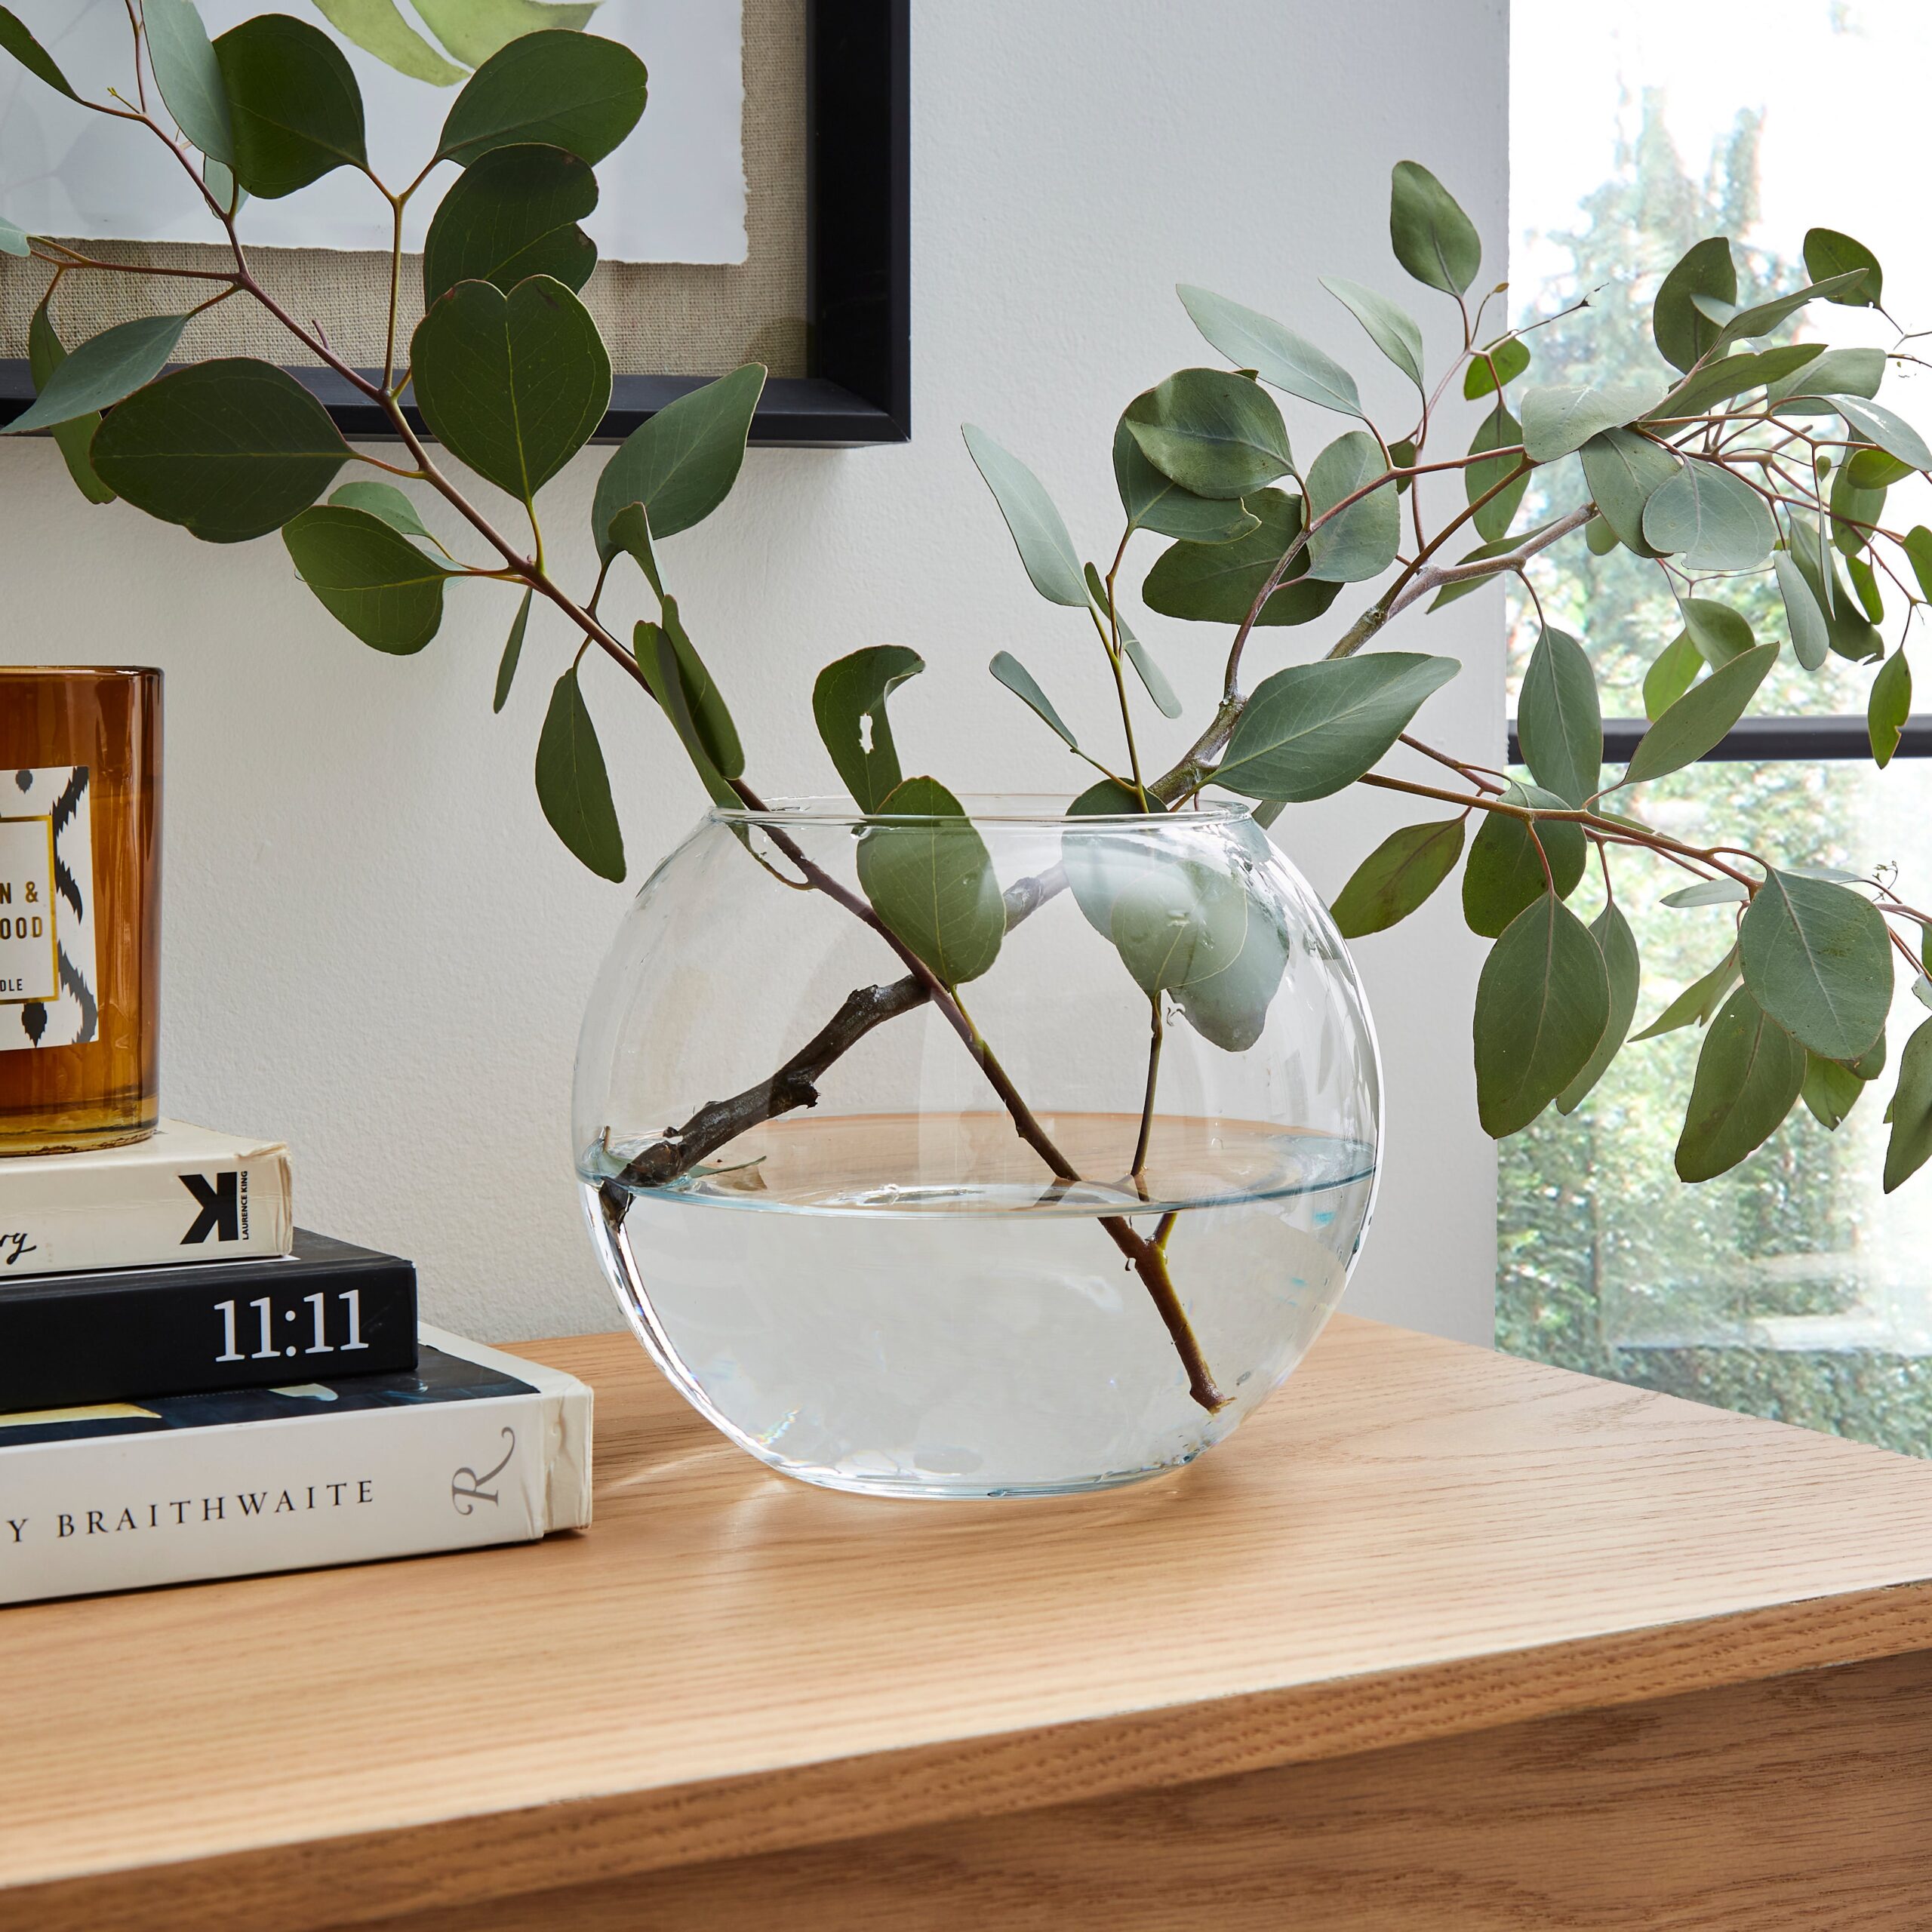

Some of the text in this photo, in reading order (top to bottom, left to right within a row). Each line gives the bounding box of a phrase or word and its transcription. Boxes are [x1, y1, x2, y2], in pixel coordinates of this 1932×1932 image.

[26, 881, 38, 903] &
[241, 1195, 249, 1240] LAURENCE
[214, 1289, 369, 1362] 11:11
[57, 1480, 374, 1538] BRAITHWAITE
